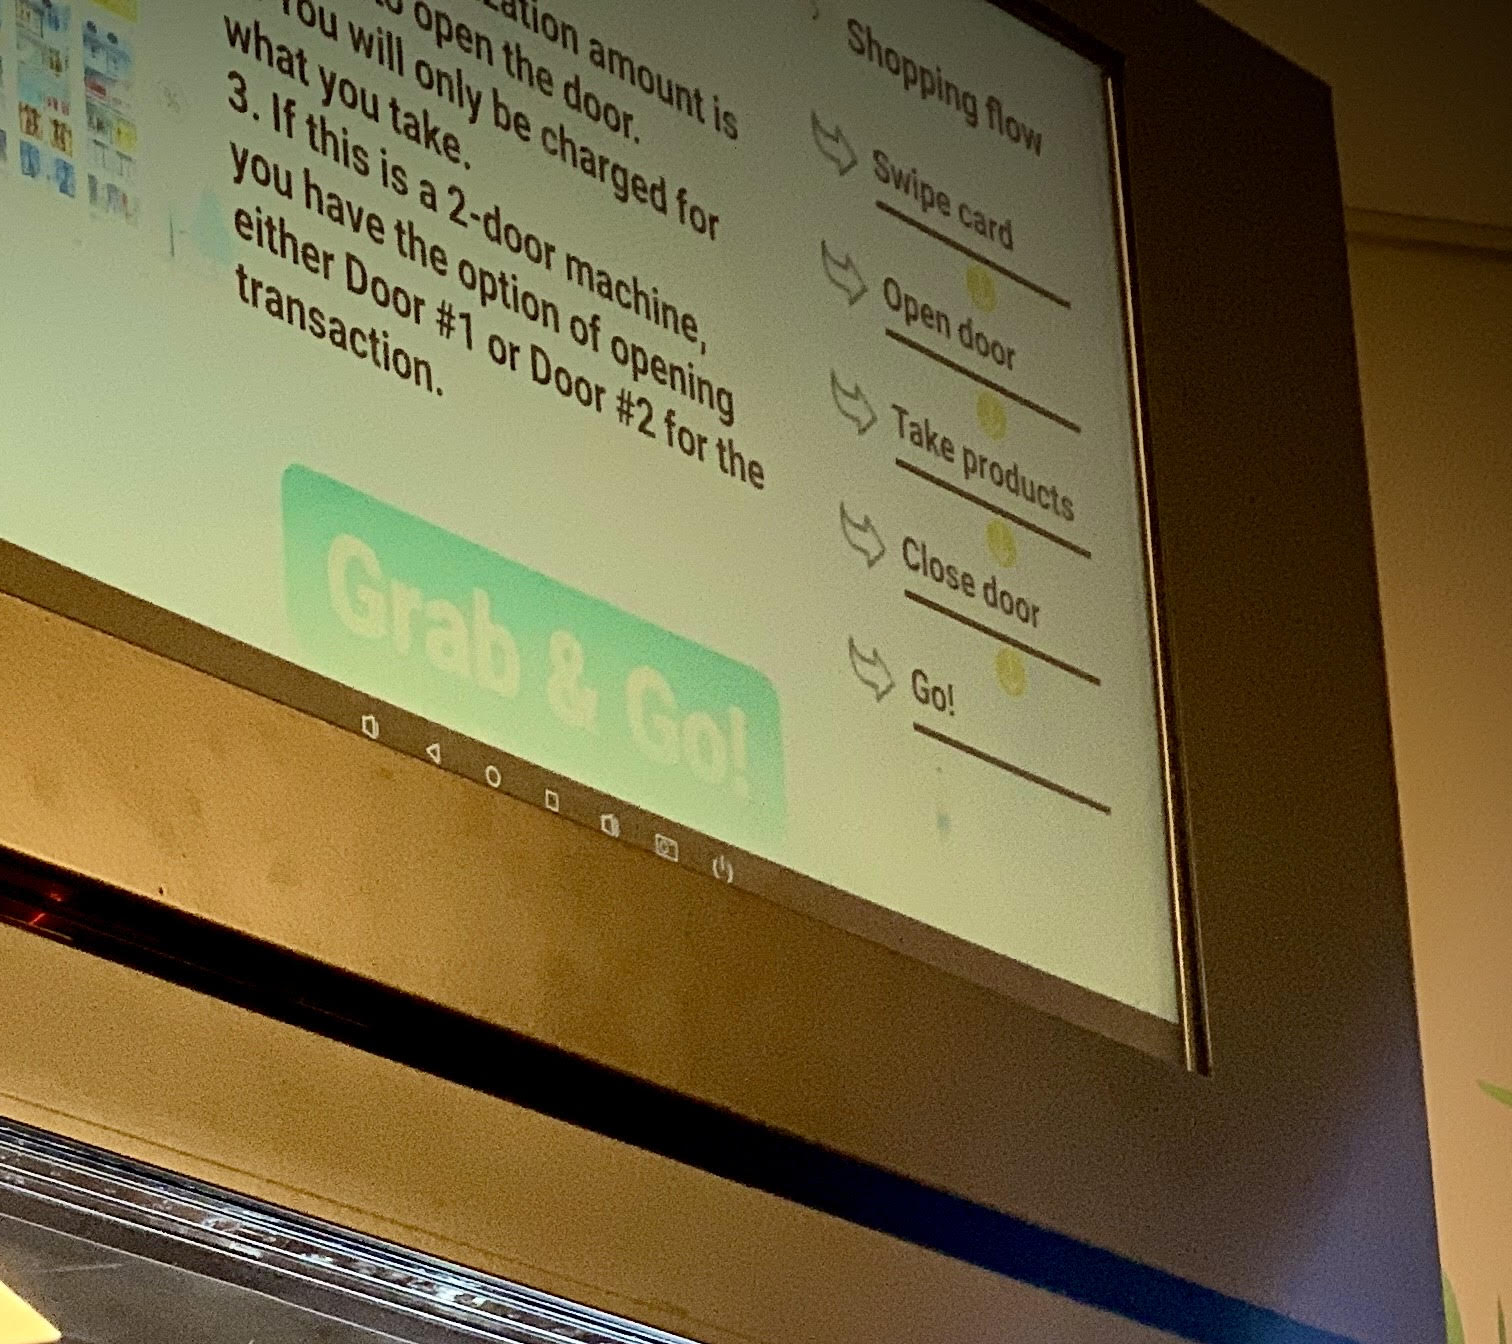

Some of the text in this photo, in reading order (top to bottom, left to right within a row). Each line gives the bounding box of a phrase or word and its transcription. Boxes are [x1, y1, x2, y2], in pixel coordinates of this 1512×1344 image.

[223, 14, 471, 171] what you take.
[348, 20, 405, 78] will
[414, 59, 482, 125] only
[491, 86, 532, 143] be
[540, 123, 668, 216] charged
[675, 187, 720, 242] for
[413, 1, 494, 67] open
[502, 40, 554, 97] the
[563, 73, 640, 145] door.
[482, 1, 738, 141] ation amount is
[847, 19, 1043, 158] Shopping flow
[227, 70, 706, 356] 3. If this is a 2-door machine,
[872, 149, 1014, 253] Swipe card
[229, 141, 735, 428] you have the option of opening
[234, 205, 765, 491] either Door #1 or Door #2 for the
[235, 263, 443, 397] transaction.
[882, 276, 1016, 372] Open door
[890, 403, 1075, 522] Take products
[902, 535, 1040, 629] Close door
[326, 533, 749, 802] Grab & Go!
[911, 668, 956, 717] Go!
